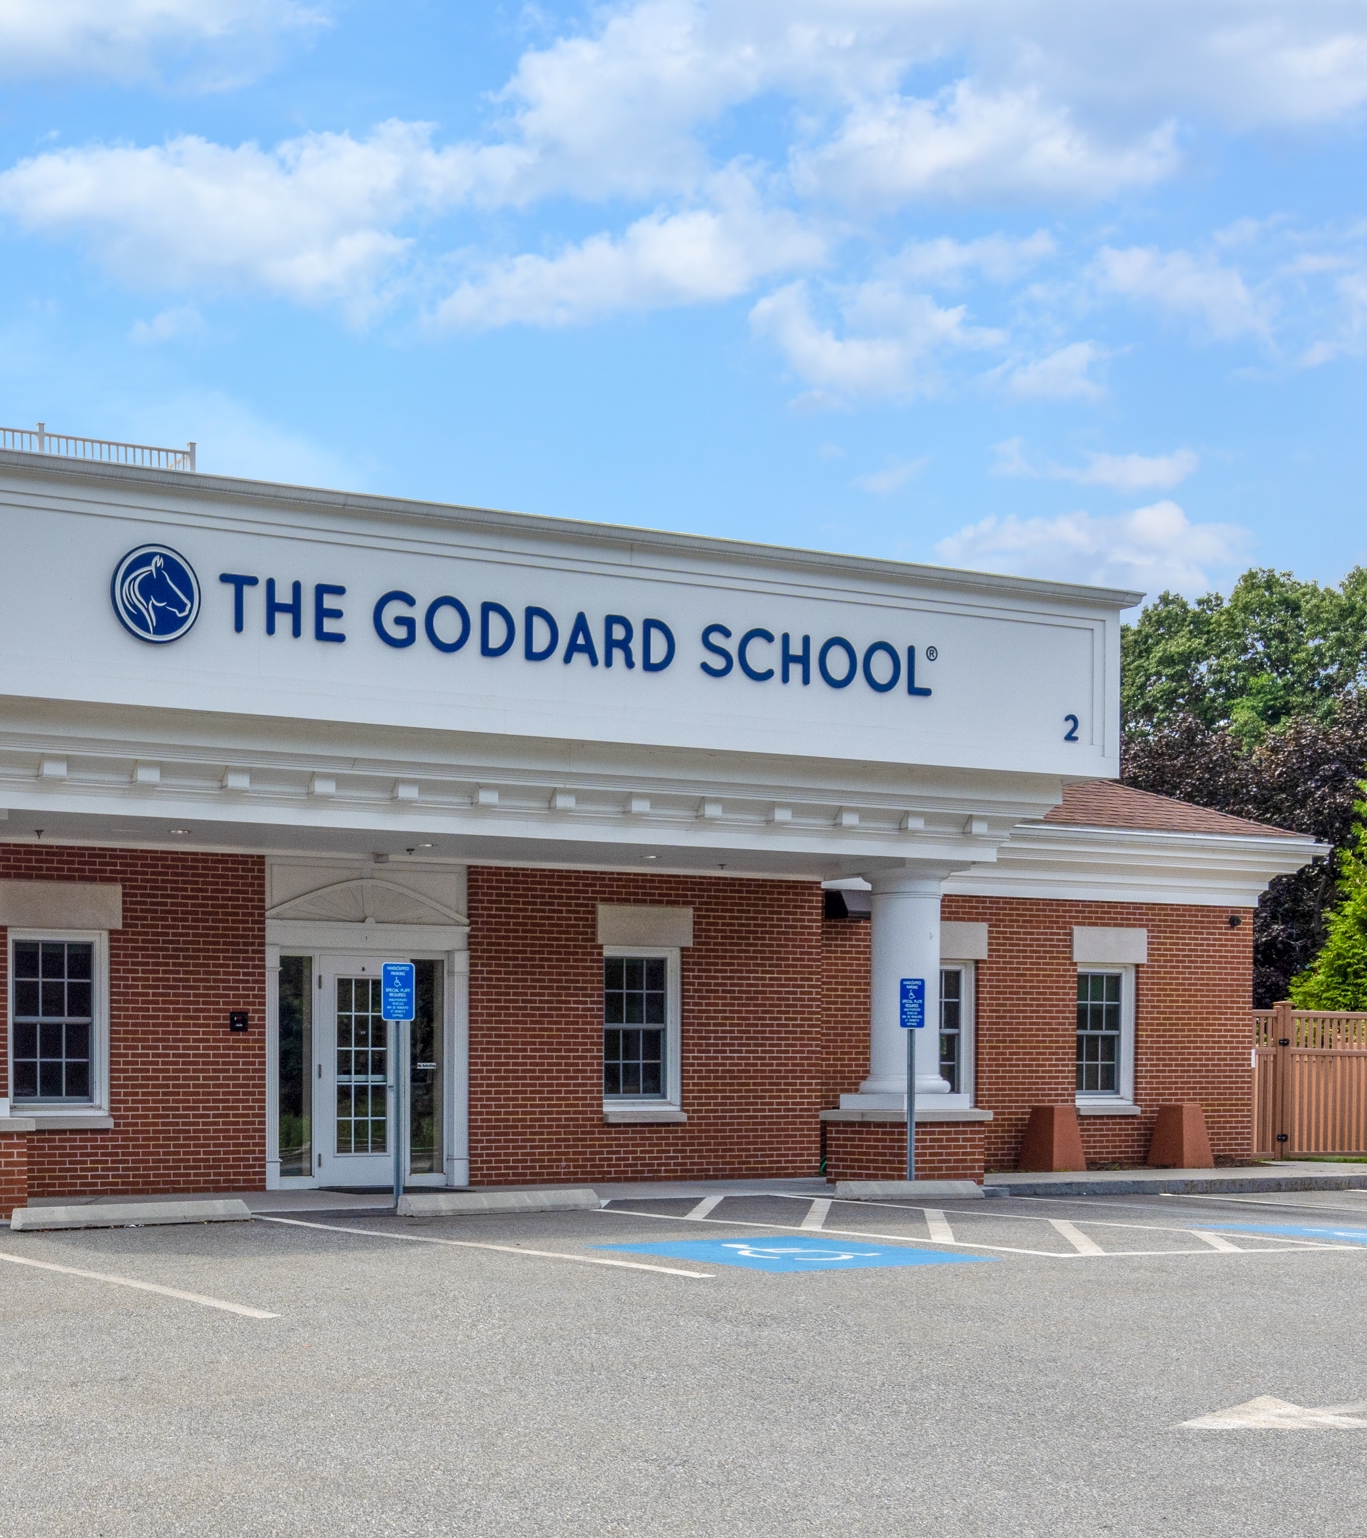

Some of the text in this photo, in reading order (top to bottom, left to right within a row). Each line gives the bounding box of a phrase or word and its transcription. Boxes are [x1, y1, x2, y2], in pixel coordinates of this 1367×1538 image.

[219, 573, 347, 643] THE
[372, 590, 677, 673] GODDARD
[1064, 714, 1079, 741] 2
